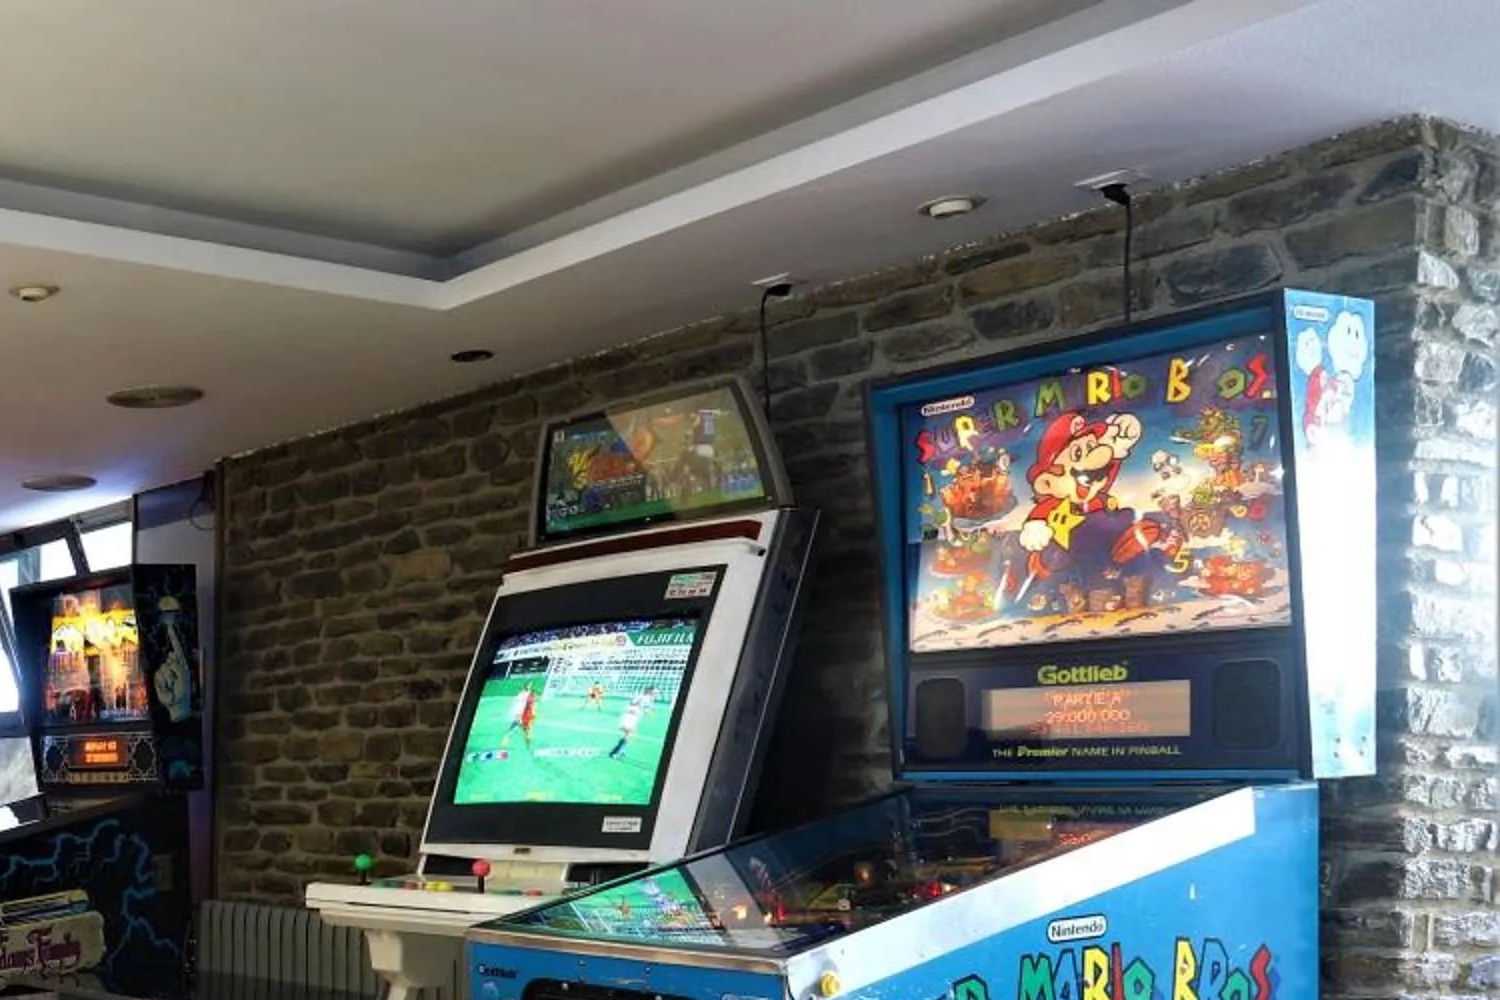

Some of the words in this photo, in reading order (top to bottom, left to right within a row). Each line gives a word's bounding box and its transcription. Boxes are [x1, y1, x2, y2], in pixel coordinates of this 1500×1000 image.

[1037, 663, 1129, 685] Gottlieb
[992, 748, 1013, 758] THE
[1017, 746, 1069, 758] Premier
[1071, 747, 1108, 757] NAME
[1111, 746, 1125, 757] IN
[1128, 745, 1182, 757] PINBALL
[1051, 918, 1104, 941] Nintendo
